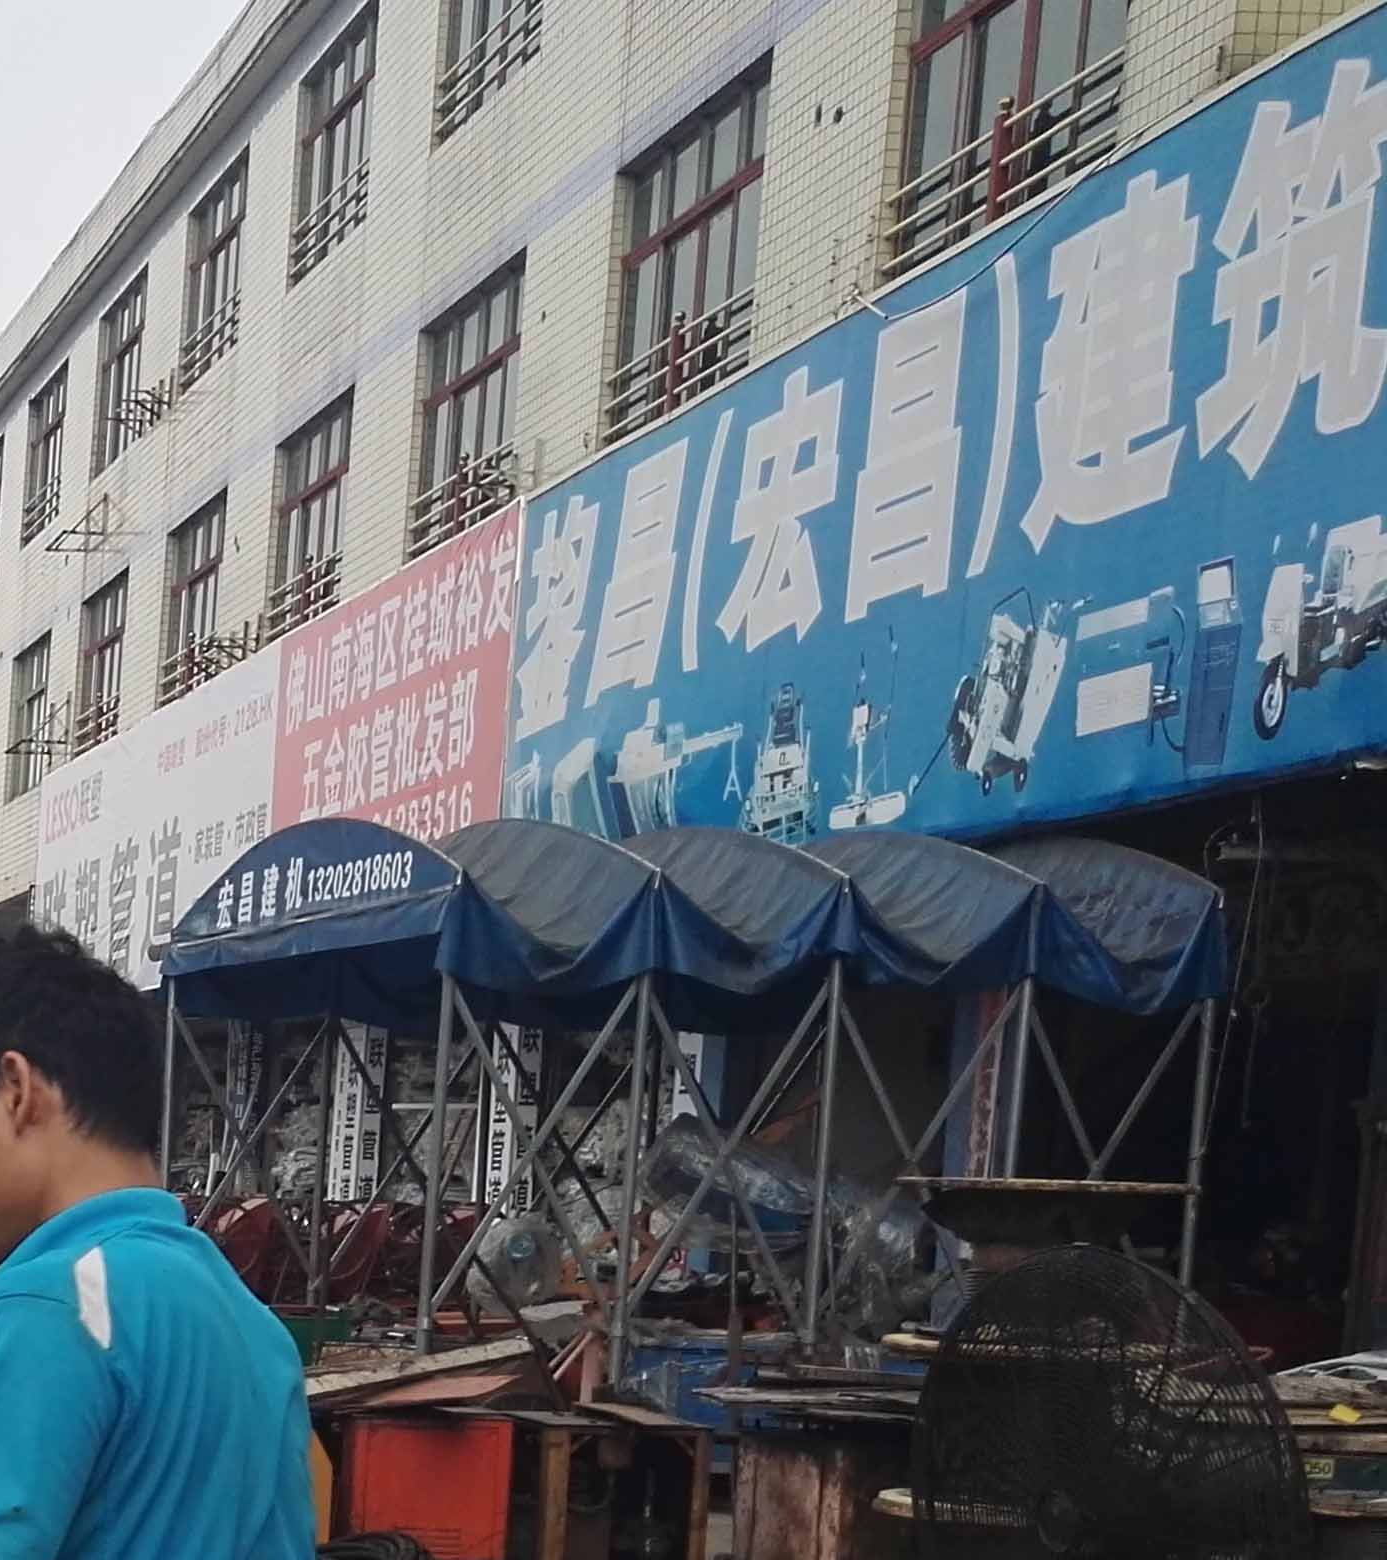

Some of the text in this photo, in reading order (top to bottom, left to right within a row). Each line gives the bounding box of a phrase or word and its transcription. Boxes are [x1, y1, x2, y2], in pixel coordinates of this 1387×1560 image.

[285, 528, 516, 737] 佛山南海区桂城裕发
[300, 667, 478, 823] 五金胶管批发部
[371, 780, 473, 841] 283516
[215, 850, 414, 929] 宏昌建机 13202818603
